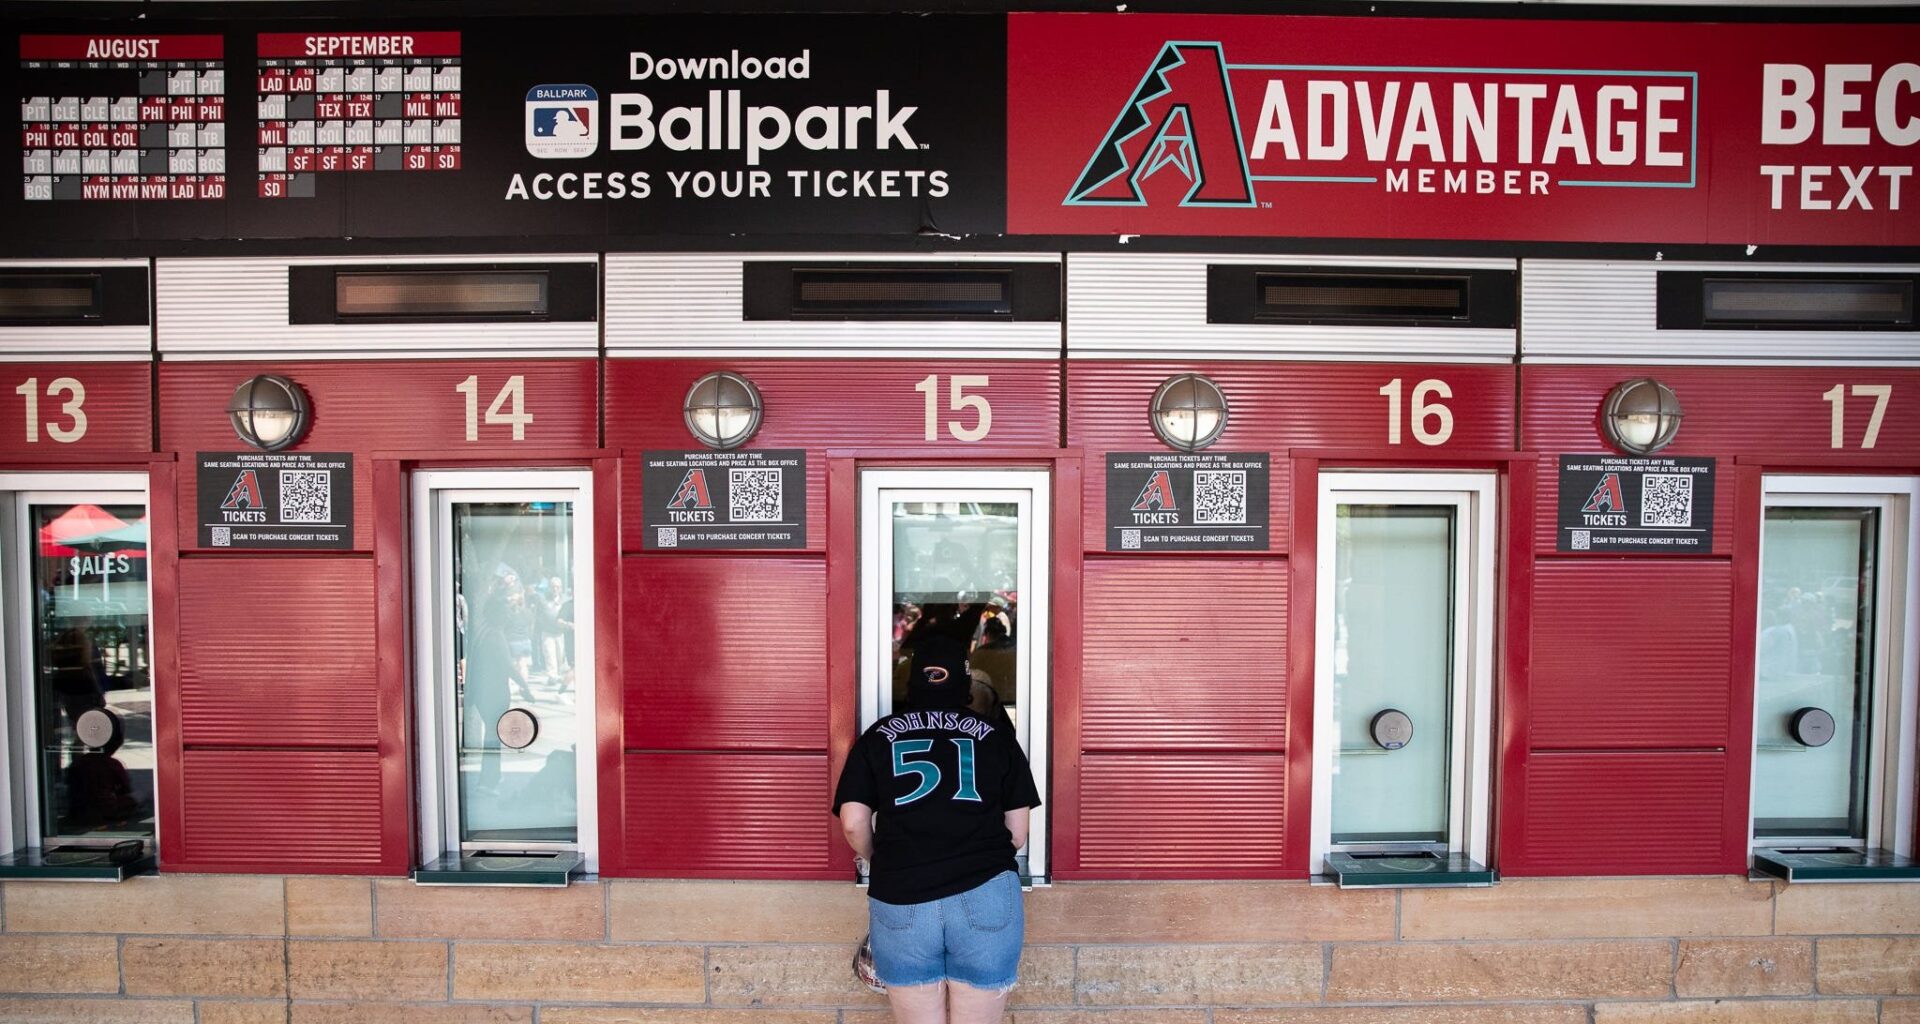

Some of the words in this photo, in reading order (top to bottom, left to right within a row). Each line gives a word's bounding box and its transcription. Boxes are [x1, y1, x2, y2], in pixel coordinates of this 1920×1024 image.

[87, 39, 160, 58] AUGUST
[305, 37, 414, 55] SEPTEMBER
[630, 49, 810, 80] Download
[172, 80, 192, 91] PIT
[202, 80, 220, 91] PIT
[261, 78, 282, 91] LAD
[290, 78, 311, 91] LAD
[323, 77, 337, 90] SF
[352, 77, 366, 90] SF
[381, 77, 395, 90] SF
[405, 77, 430, 90] HOU
[435, 77, 459, 89] HOU
[537, 90, 587, 98] BALLPARK
[27, 106, 45, 120] PIT
[54, 106, 77, 120] CLE
[84, 106, 106, 120] CLE
[114, 106, 136, 120] CLE
[142, 107, 163, 120] PHI
[172, 107, 192, 120] PHI
[201, 106, 221, 120] PHI
[261, 104, 283, 117] HOU
[319, 104, 341, 117] TEX
[349, 103, 370, 117] TEX
[407, 103, 428, 116] MIL
[437, 103, 458, 116] MIL
[1760, 63, 1920, 146] BEC
[610, 89, 918, 165] Ballpark
[1250, 79, 1685, 166] ADVANTAGE
[26, 134, 47, 146] PHI
[55, 133, 78, 146] COL
[84, 133, 108, 146] COL
[113, 133, 136, 146] COL
[175, 132, 189, 145] TB
[204, 132, 218, 145] TB
[262, 130, 283, 144] MIL
[378, 129, 399, 143] MIL
[407, 129, 429, 142] MIL
[437, 129, 458, 142] MIL
[30, 159, 45, 172] TB
[294, 156, 308, 170] SF
[323, 156, 337, 169] SF
[352, 156, 367, 169] SF
[410, 155, 425, 169] SD
[439, 155, 455, 168] SD
[264, 183, 280, 196] SD
[505, 172, 651, 200] ACCESS
[667, 171, 771, 198] YOUR
[788, 170, 949, 197] TICKETS
[1386, 168, 1550, 196] MEMBER
[1760, 165, 1912, 211] TEXT
[84, 185, 109, 198] NYM
[112, 185, 138, 198] NYM
[142, 185, 167, 198] NYM
[172, 185, 194, 198] LAD
[202, 185, 223, 198] LAD
[15, 377, 88, 443] 13
[455, 375, 534, 442] 14
[915, 374, 992, 442] 15
[1379, 378, 1454, 446] 16
[1823, 384, 1892, 449] 17
[222, 511, 266, 522] TICKETS
[669, 511, 715, 522] TICKETS
[1133, 513, 1178, 523] TICKETS
[1583, 515, 1627, 525] TICKETS
[70, 554, 130, 576] SALES
[876, 711, 995, 742] JOHNSON
[892, 738, 982, 806] 51
